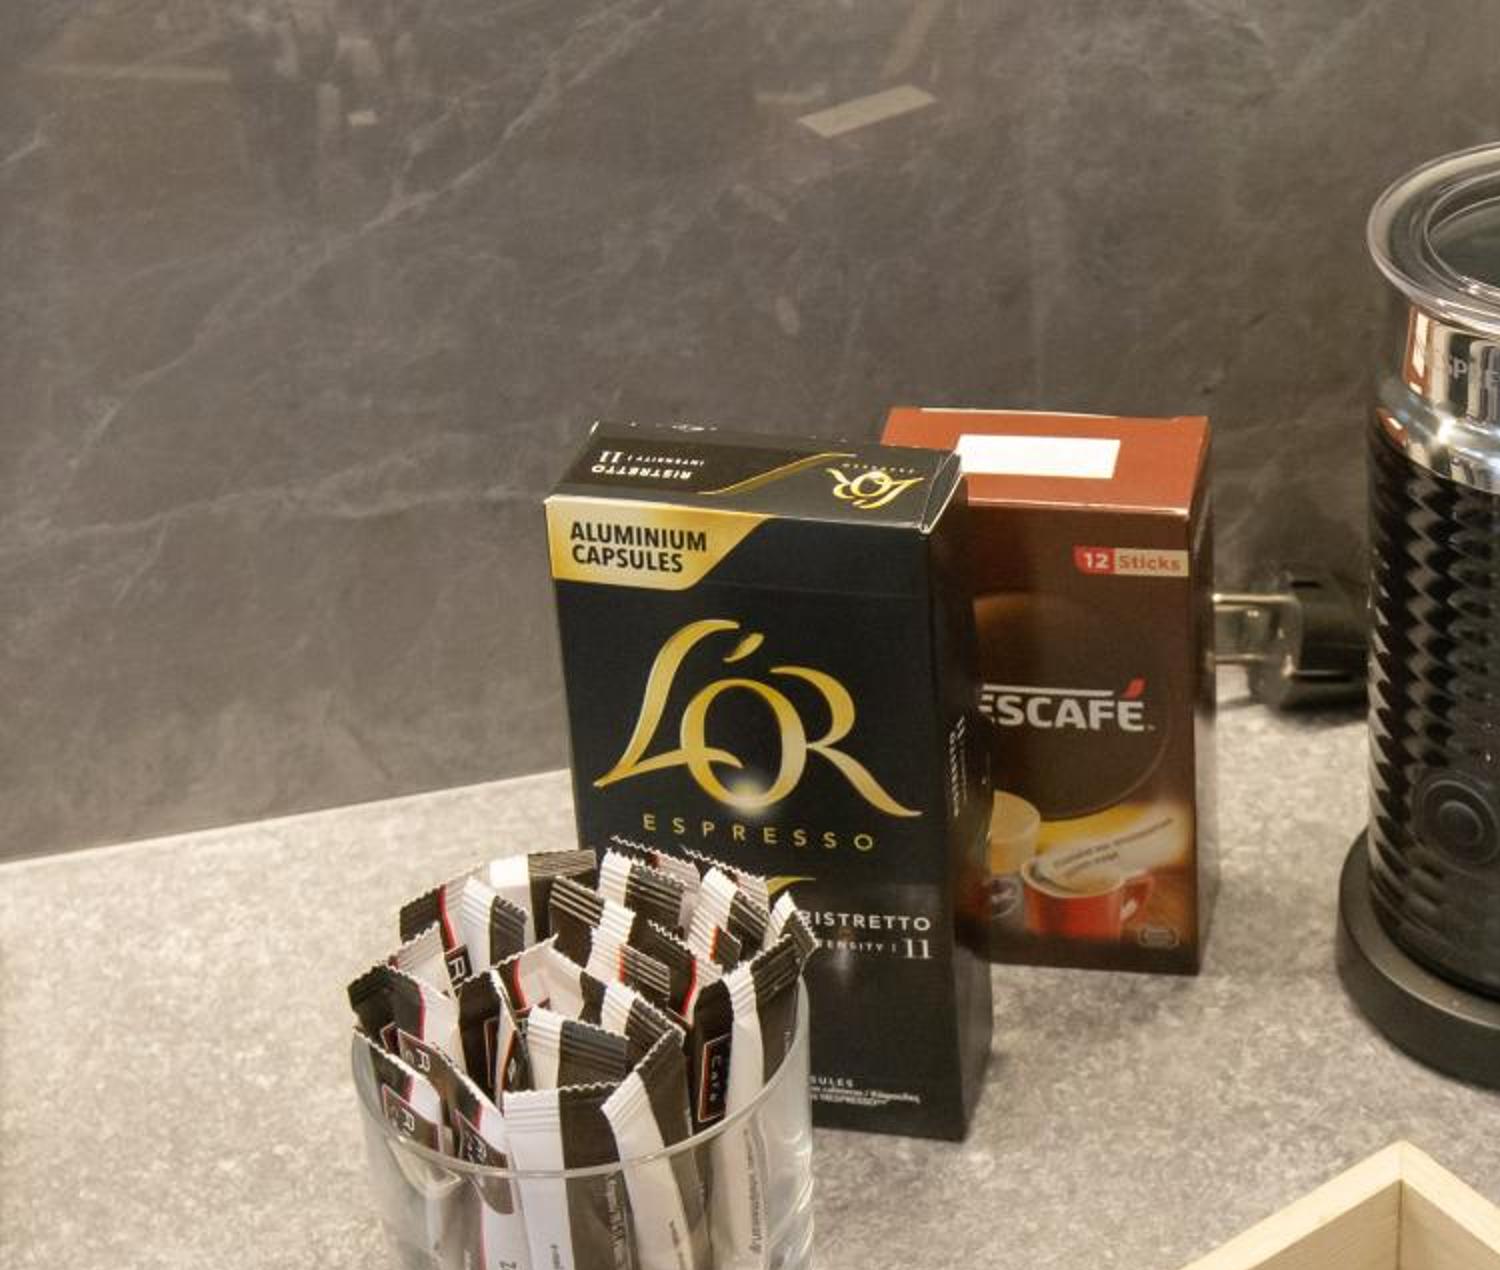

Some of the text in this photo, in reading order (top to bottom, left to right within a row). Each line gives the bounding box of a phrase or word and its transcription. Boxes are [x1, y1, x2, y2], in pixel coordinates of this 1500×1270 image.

[591, 464, 693, 481] RISTRETTO
[570, 521, 708, 552] ALUMINIUM
[572, 544, 684, 573] CAPSULES
[1082, 551, 1182, 573] 12 Sticks
[643, 813, 874, 852] ESPRESSO
[903, 938, 933, 960] 11
